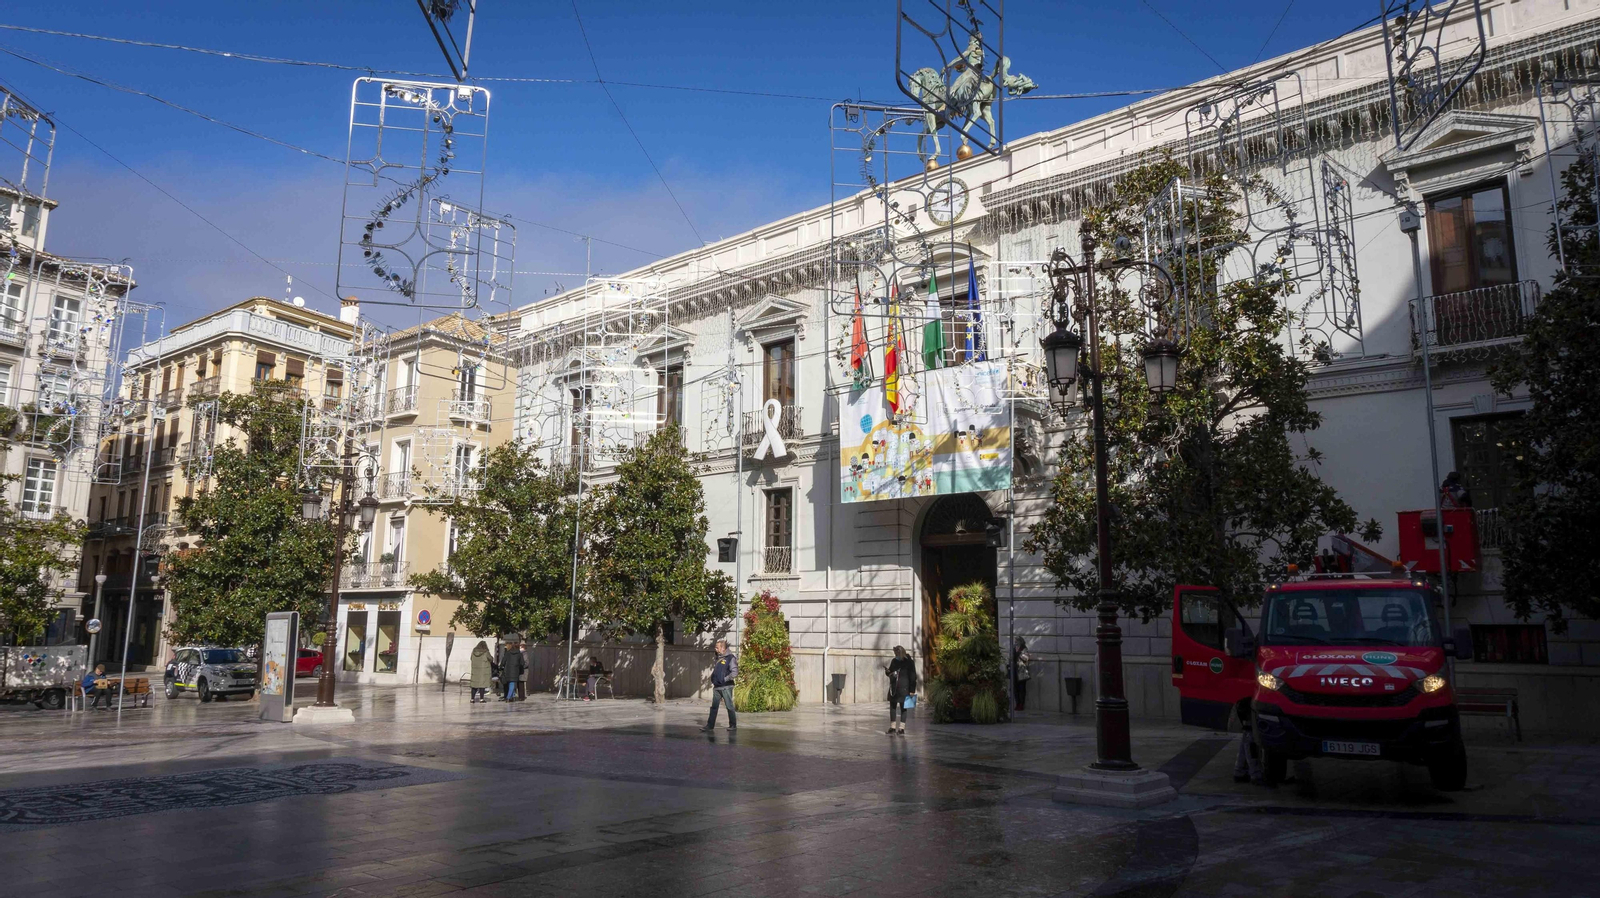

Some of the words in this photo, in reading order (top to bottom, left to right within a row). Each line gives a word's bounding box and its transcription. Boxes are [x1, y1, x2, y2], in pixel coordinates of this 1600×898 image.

[1320, 677, 1374, 687] IVECO
[1329, 742, 1354, 753] 6119
[1358, 744, 1377, 754] JGS
